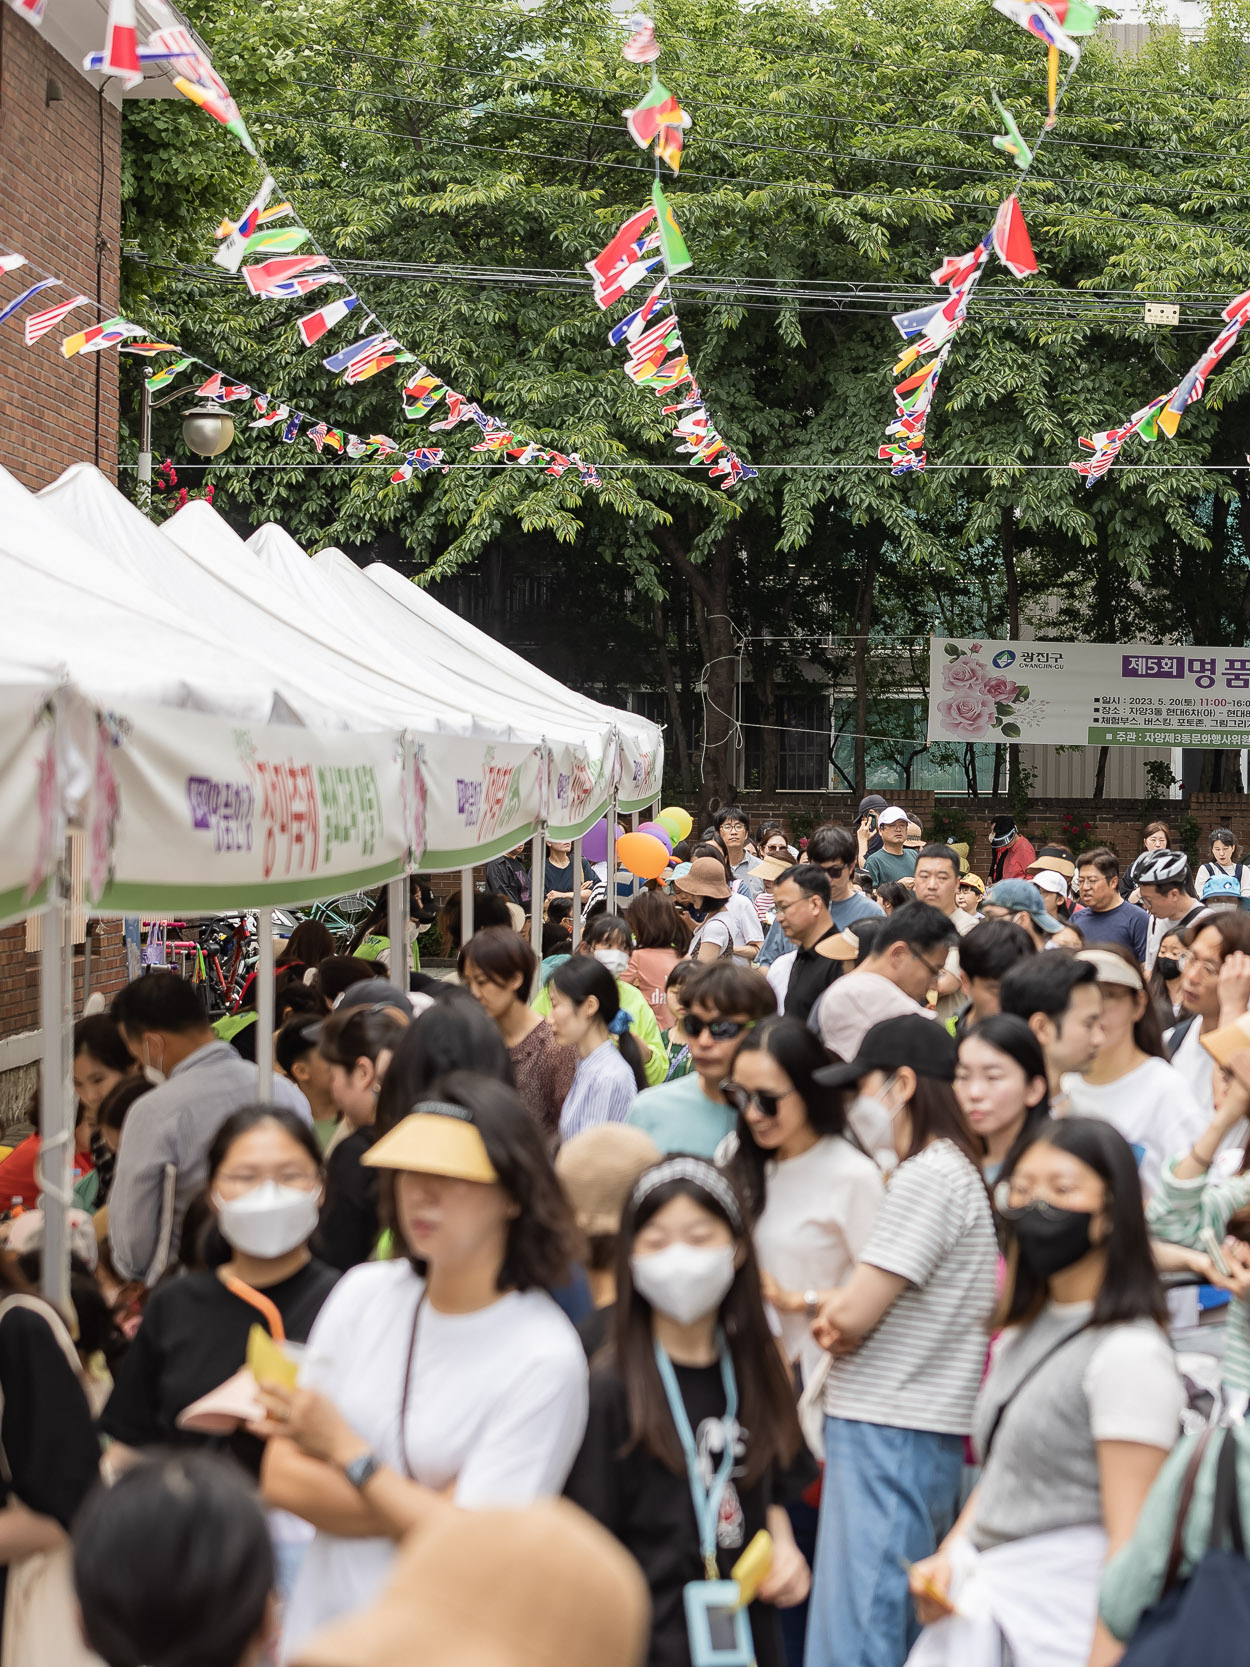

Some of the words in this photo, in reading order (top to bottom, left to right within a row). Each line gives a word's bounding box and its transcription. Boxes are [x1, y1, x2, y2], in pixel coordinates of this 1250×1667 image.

[1020, 651, 1064, 663] 광진구
[1128, 657, 1177, 676] 제5회
[1102, 696, 1120, 705] 일시
[1129, 697, 1155, 706] 2023.
[1169, 698, 1196, 707] 20(토)
[1101, 707, 1120, 715] 장소
[1129, 707, 1163, 717] 자양3동
[1166, 708, 1216, 718] 현대6차(아)
[1116, 731, 1137, 743] 주관
